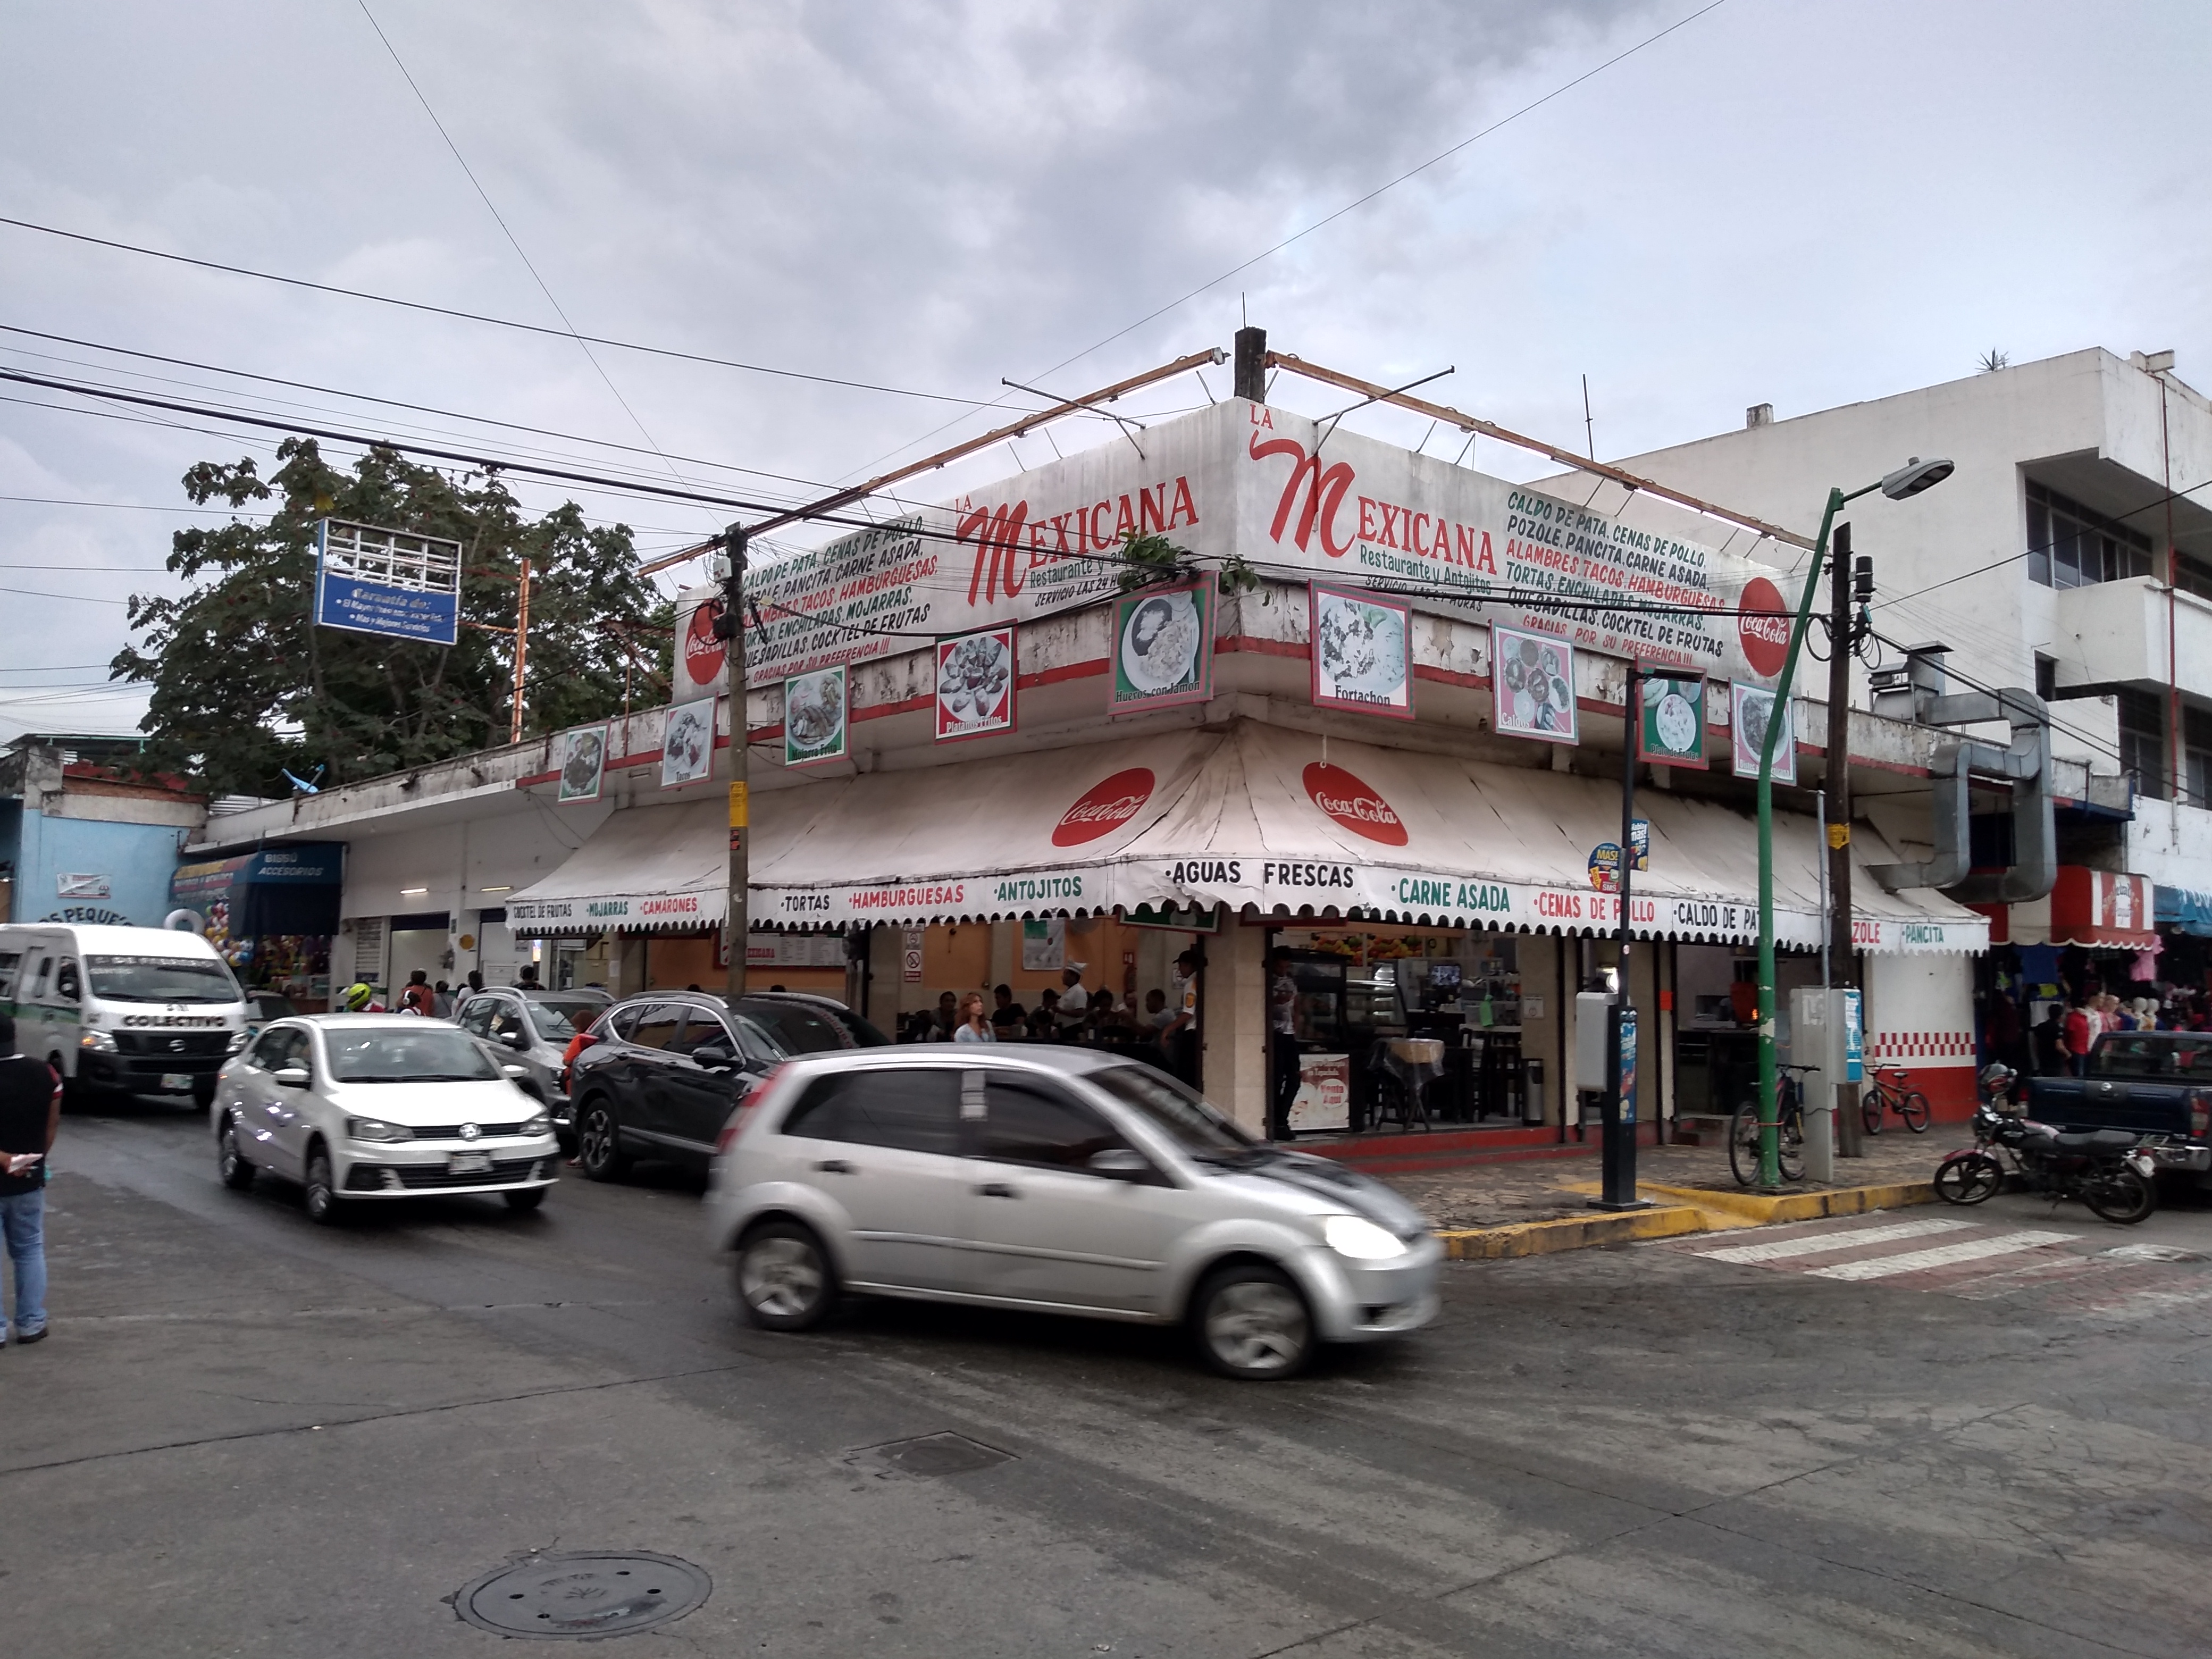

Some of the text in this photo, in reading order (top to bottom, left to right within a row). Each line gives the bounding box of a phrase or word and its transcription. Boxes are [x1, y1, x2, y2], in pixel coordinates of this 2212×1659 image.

[1250, 404, 1273, 430] LA
[956, 495, 971, 514] LA
[1250, 429, 1497, 575] MEXICANA
[1507, 491, 1553, 521] CALDO
[1555, 506, 1575, 528] DE
[1613, 524, 1652, 552] CENAS
[1653, 537, 1669, 556] DE
[957, 476, 1199, 607] MEXICANA
[743, 567, 773, 592] CALDO
[774, 562, 789, 581] DE
[824, 537, 860, 565] CENAS
[862, 530, 881, 552] DE
[835, 552, 875, 582] CARNE
[1030, 558, 1092, 589] Restaurante
[1360, 544, 1430, 580] Restaurante
[1444, 566, 1492, 595] Antojitos
[1626, 551, 1666, 577] CARNE
[1035, 586, 1075, 607] SERVICIO
[1076, 580, 1095, 595] LAS
[1095, 576, 1108, 591] 24
[1365, 576, 1407, 591] SERVICIO
[811, 623, 860, 651] COCKTEL
[862, 617, 878, 637] DE
[879, 602, 931, 632] FRUTAS
[1523, 614, 1568, 635] GRACIAS
[1574, 627, 1597, 645] POR
[1602, 634, 1616, 649] SU
[1602, 610, 1654, 640] COCKTEL
[1657, 625, 1673, 645] DE
[1676, 630, 1724, 658] FRUTAS
[753, 662, 787, 683] GRACIAS
[787, 659, 805, 672] POR
[806, 653, 818, 669] SU
[1116, 689, 1147, 703] Huevos
[1151, 685, 1168, 697] con
[1335, 684, 1391, 707] Fortachon
[946, 715, 1002, 733] Platanos Fritos
[1502, 712, 1530, 728] Caldos
[1650, 743, 1699, 761] Plato de Frutas
[675, 770, 691, 782] Tacos
[1060, 793, 1149, 825] Coca-Cola
[1315, 791, 1398, 825] Coca-Cola
[258, 867, 324, 876] ACCESORIOS
[1172, 861, 1354, 888] AGUAS FRESCAS
[852, 884, 965, 909] HAMBURGUESAS
[996, 876, 1082, 902] ANTOJITOS
[1399, 877, 1511, 913] CARNE ASADA
[538, 904, 546, 918] DE
[547, 903, 572, 918] FRUTAS
[589, 901, 629, 917] MOJARRAS
[643, 897, 698, 915] CAMARONES
[784, 894, 830, 912] TORTAS
[1538, 891, 1655, 923] CENAS DE PLLO
[1678, 902, 1717, 927] CALDO
[1722, 906, 1737, 929] DE
[1852, 923, 1880, 944] ZOLE
[1905, 925, 1945, 944] PANCITA
[1320, 1085, 1344, 1094] Venta
